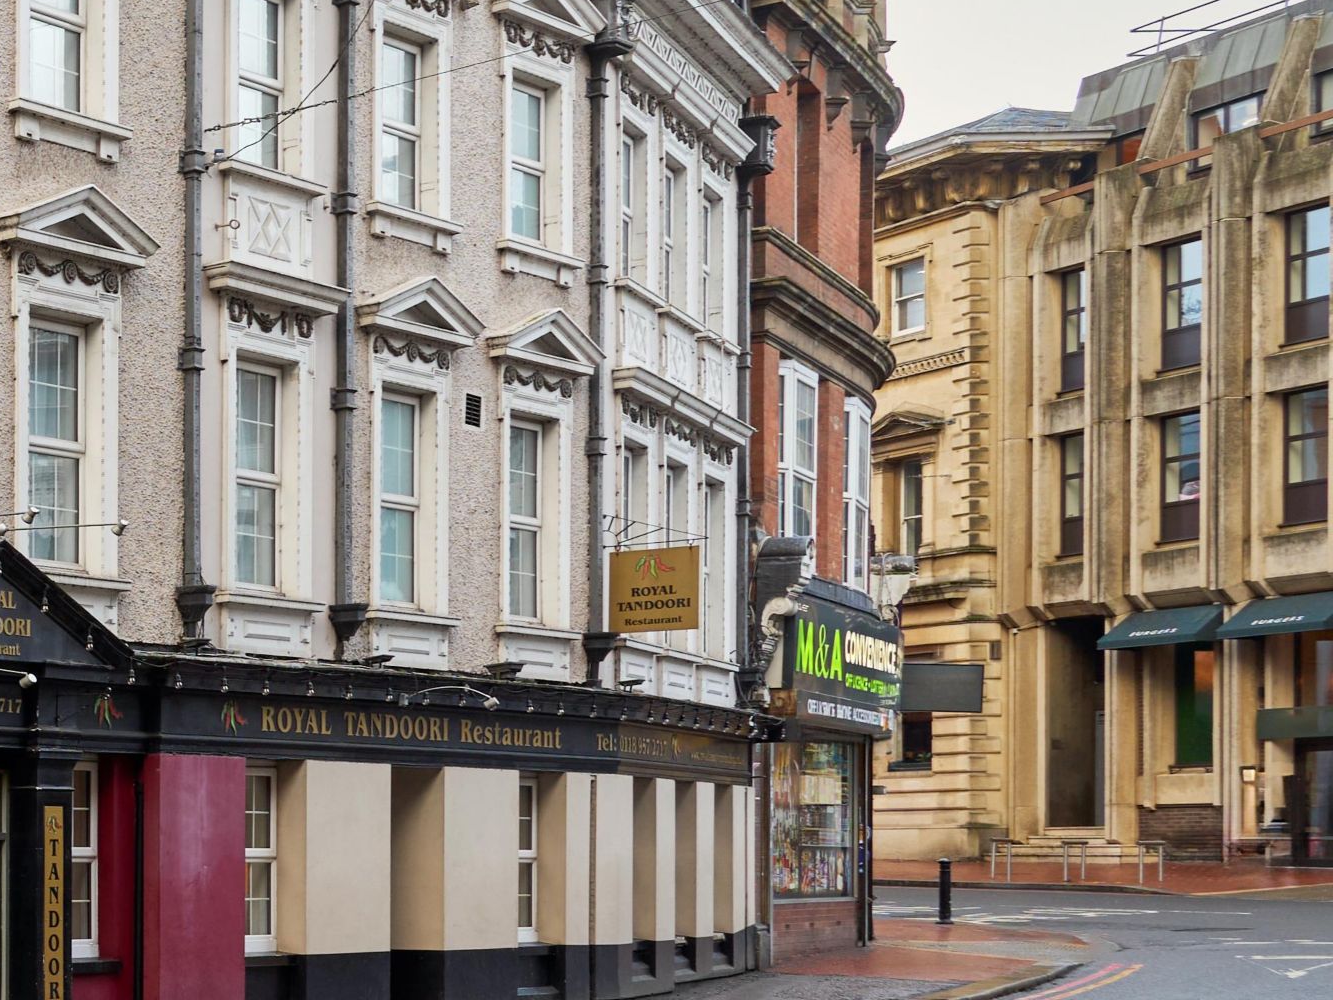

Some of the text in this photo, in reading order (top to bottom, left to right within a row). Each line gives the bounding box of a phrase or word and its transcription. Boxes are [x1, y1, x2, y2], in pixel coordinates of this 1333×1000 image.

[631, 585, 678, 598] ROYAL
[617, 597, 691, 612] TANDOORI
[624, 615, 683, 627] Restaurant
[261, 705, 562, 749] ROYAL TANDOORI Restaurant
[596, 733, 617, 751] Tel:
